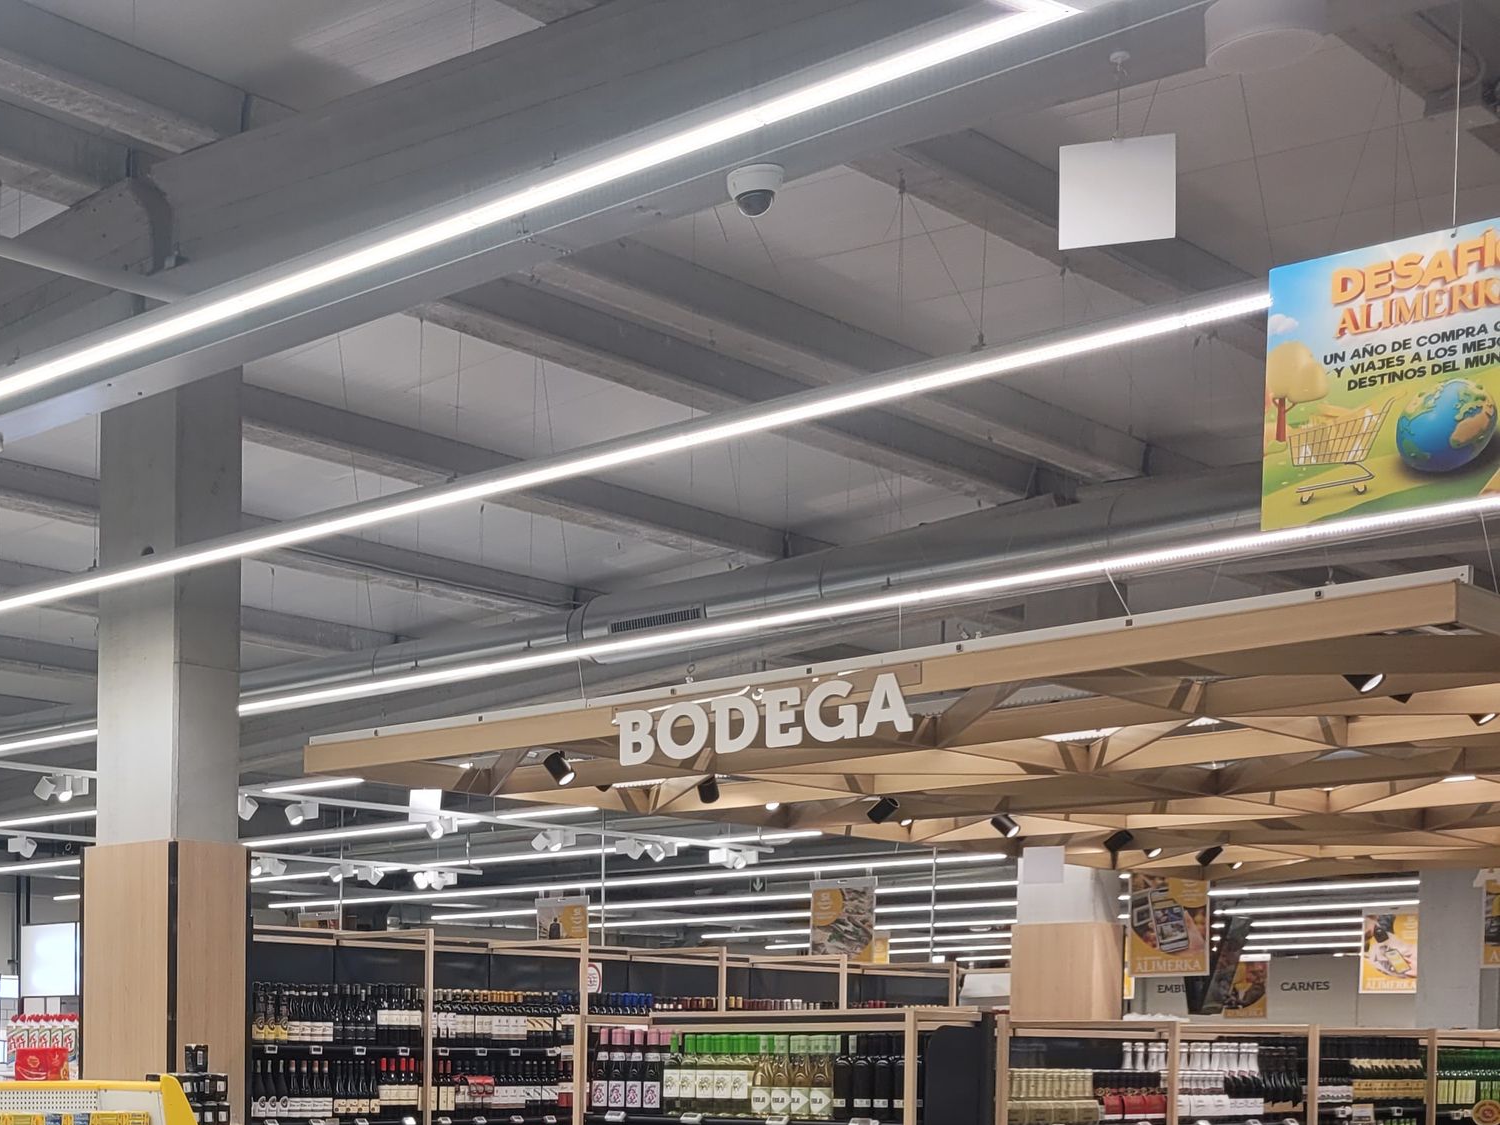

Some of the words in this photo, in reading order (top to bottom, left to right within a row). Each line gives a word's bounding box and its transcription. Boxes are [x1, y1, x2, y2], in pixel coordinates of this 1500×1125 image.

[1323, 351, 1345, 366] UN
[1350, 342, 1387, 360] AÑO
[1391, 338, 1411, 352] DE
[1416, 323, 1488, 347] COMPRA
[1333, 366, 1345, 378] Y
[1350, 354, 1405, 376] VIAJES
[1410, 352, 1422, 364] A
[1427, 345, 1457, 361] LOS
[1348, 367, 1427, 391] DESTINOS
[1431, 361, 1461, 376] DEL
[614, 673, 914, 767] BODEGA
[1136, 959, 1202, 972] ALIMERKA
[1280, 981, 1330, 991] CARNES
